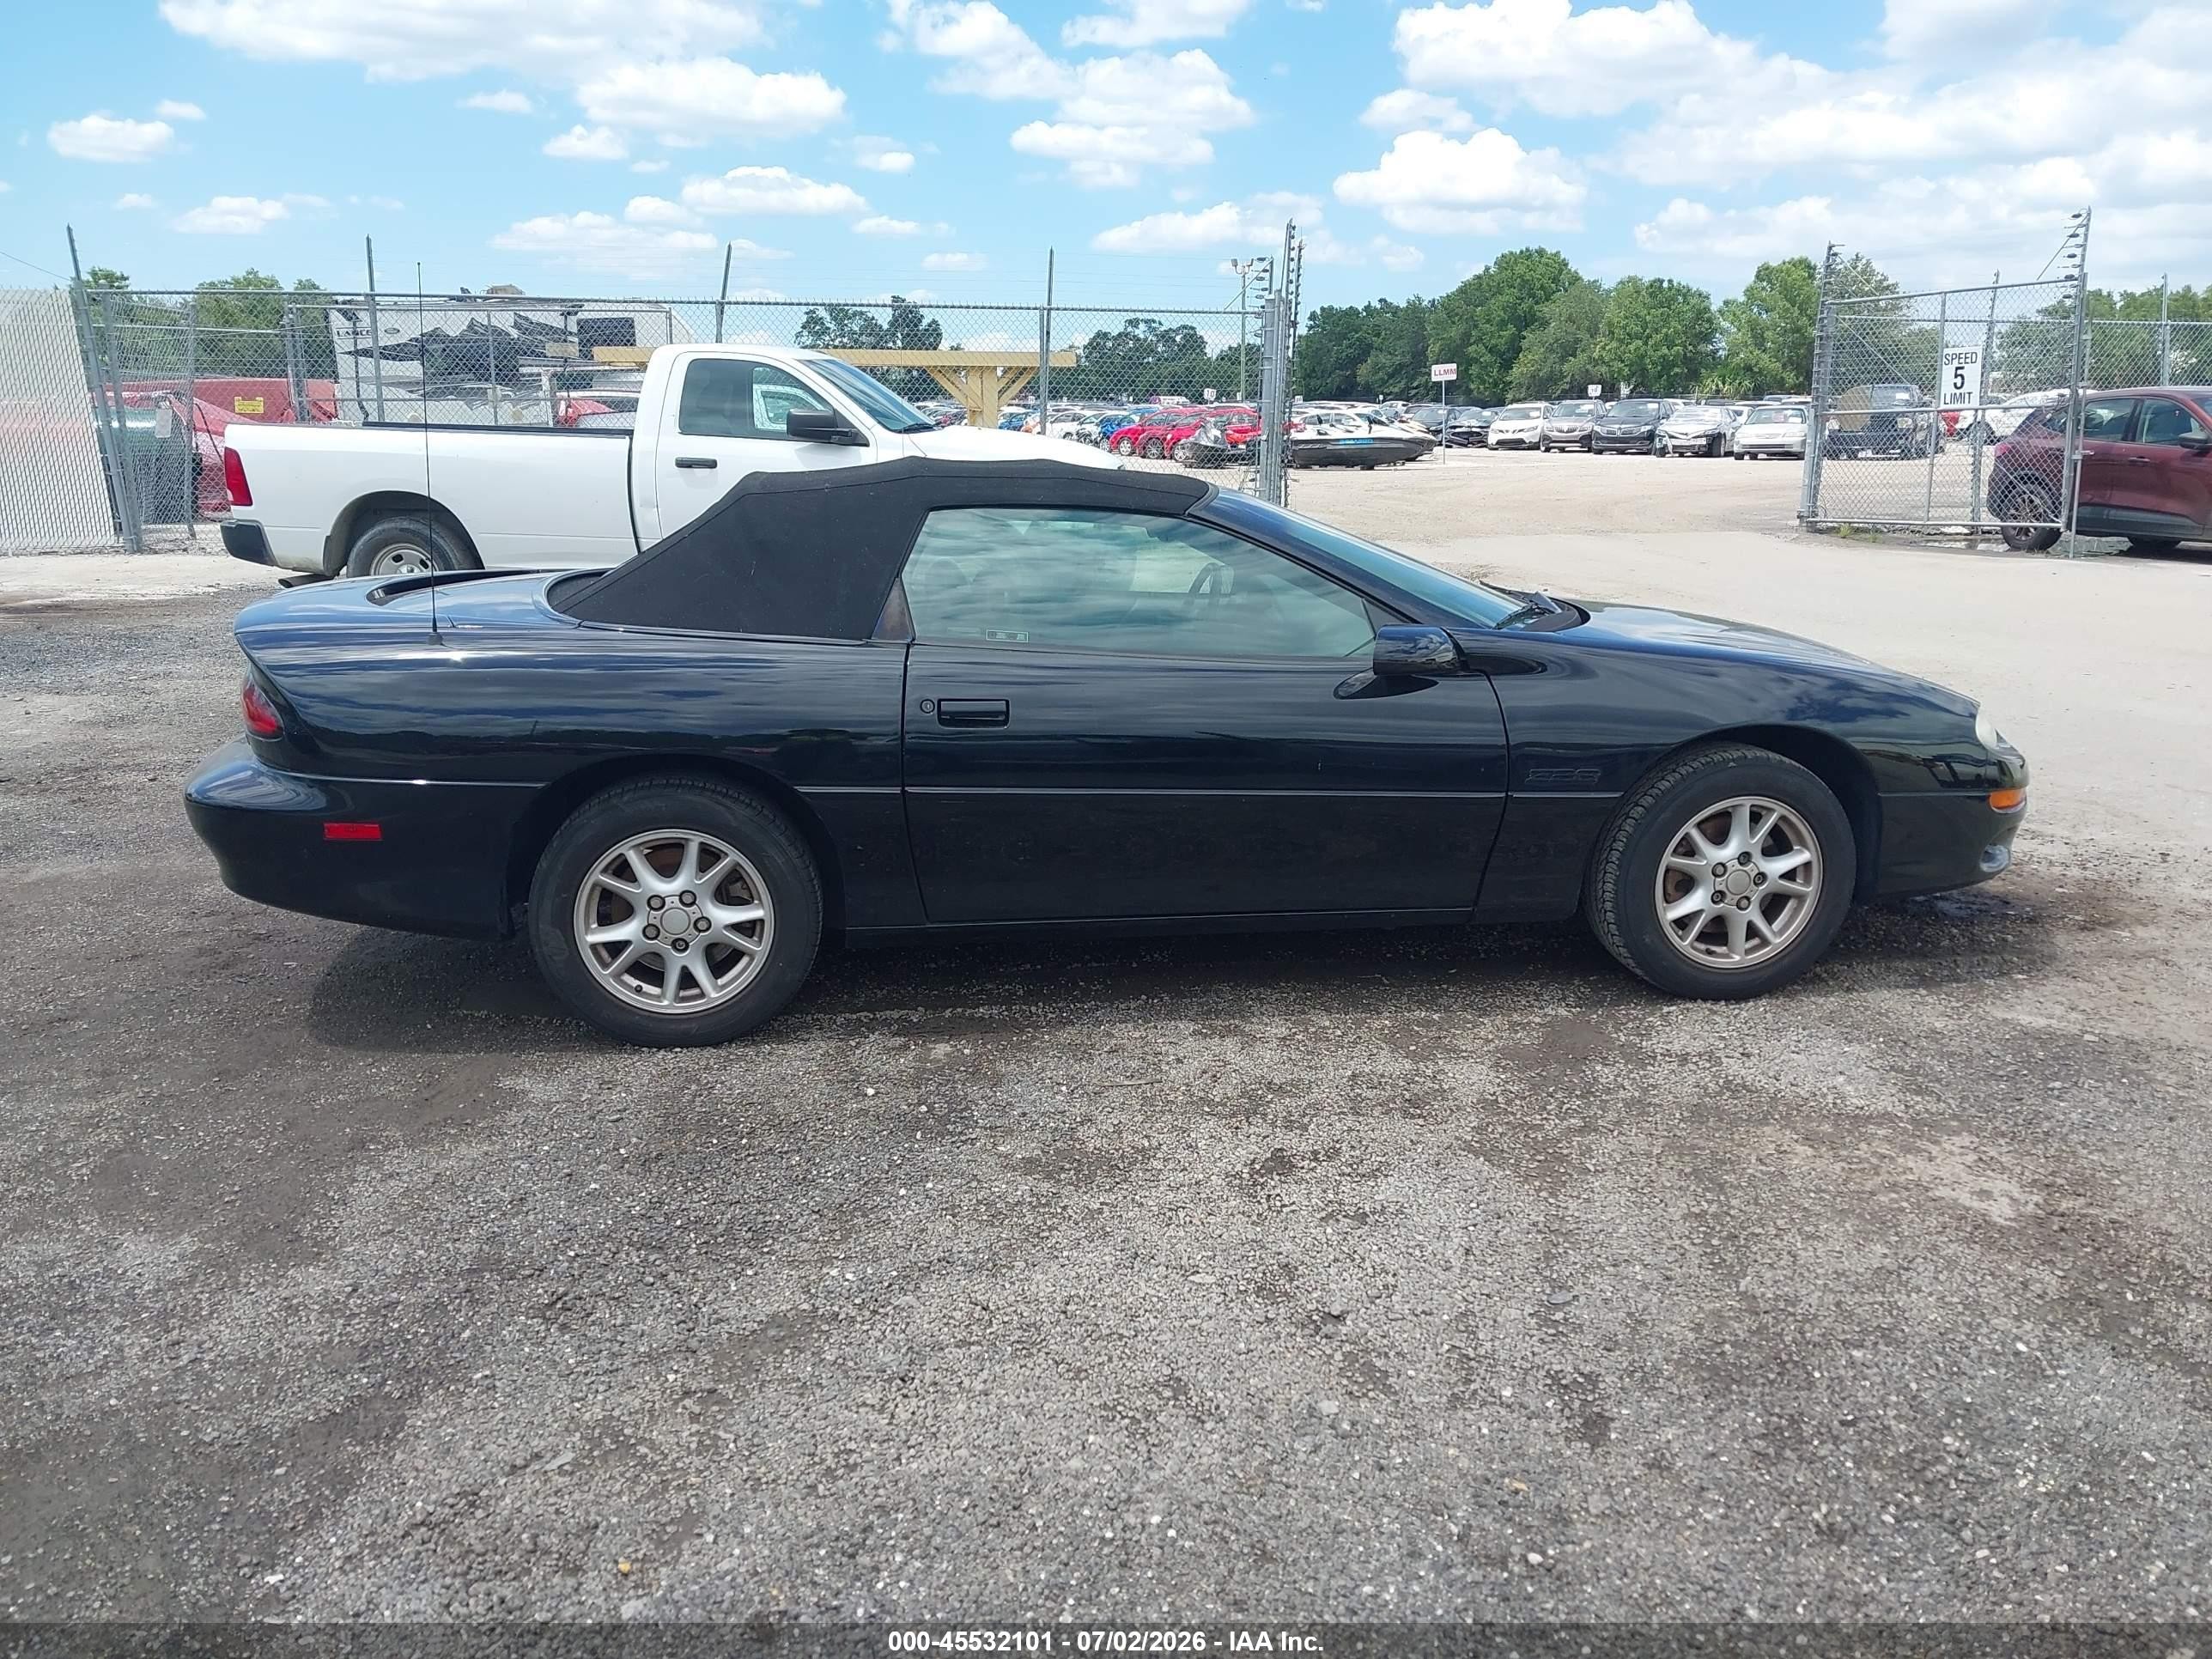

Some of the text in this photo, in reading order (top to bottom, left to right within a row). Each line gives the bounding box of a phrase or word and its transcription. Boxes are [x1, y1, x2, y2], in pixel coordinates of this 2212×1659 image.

[1943, 351, 1978, 366] SPEED
[1433, 368, 1456, 376] LLMM
[1953, 366, 1966, 390] 5
[1943, 392, 1973, 405] LIMIT
